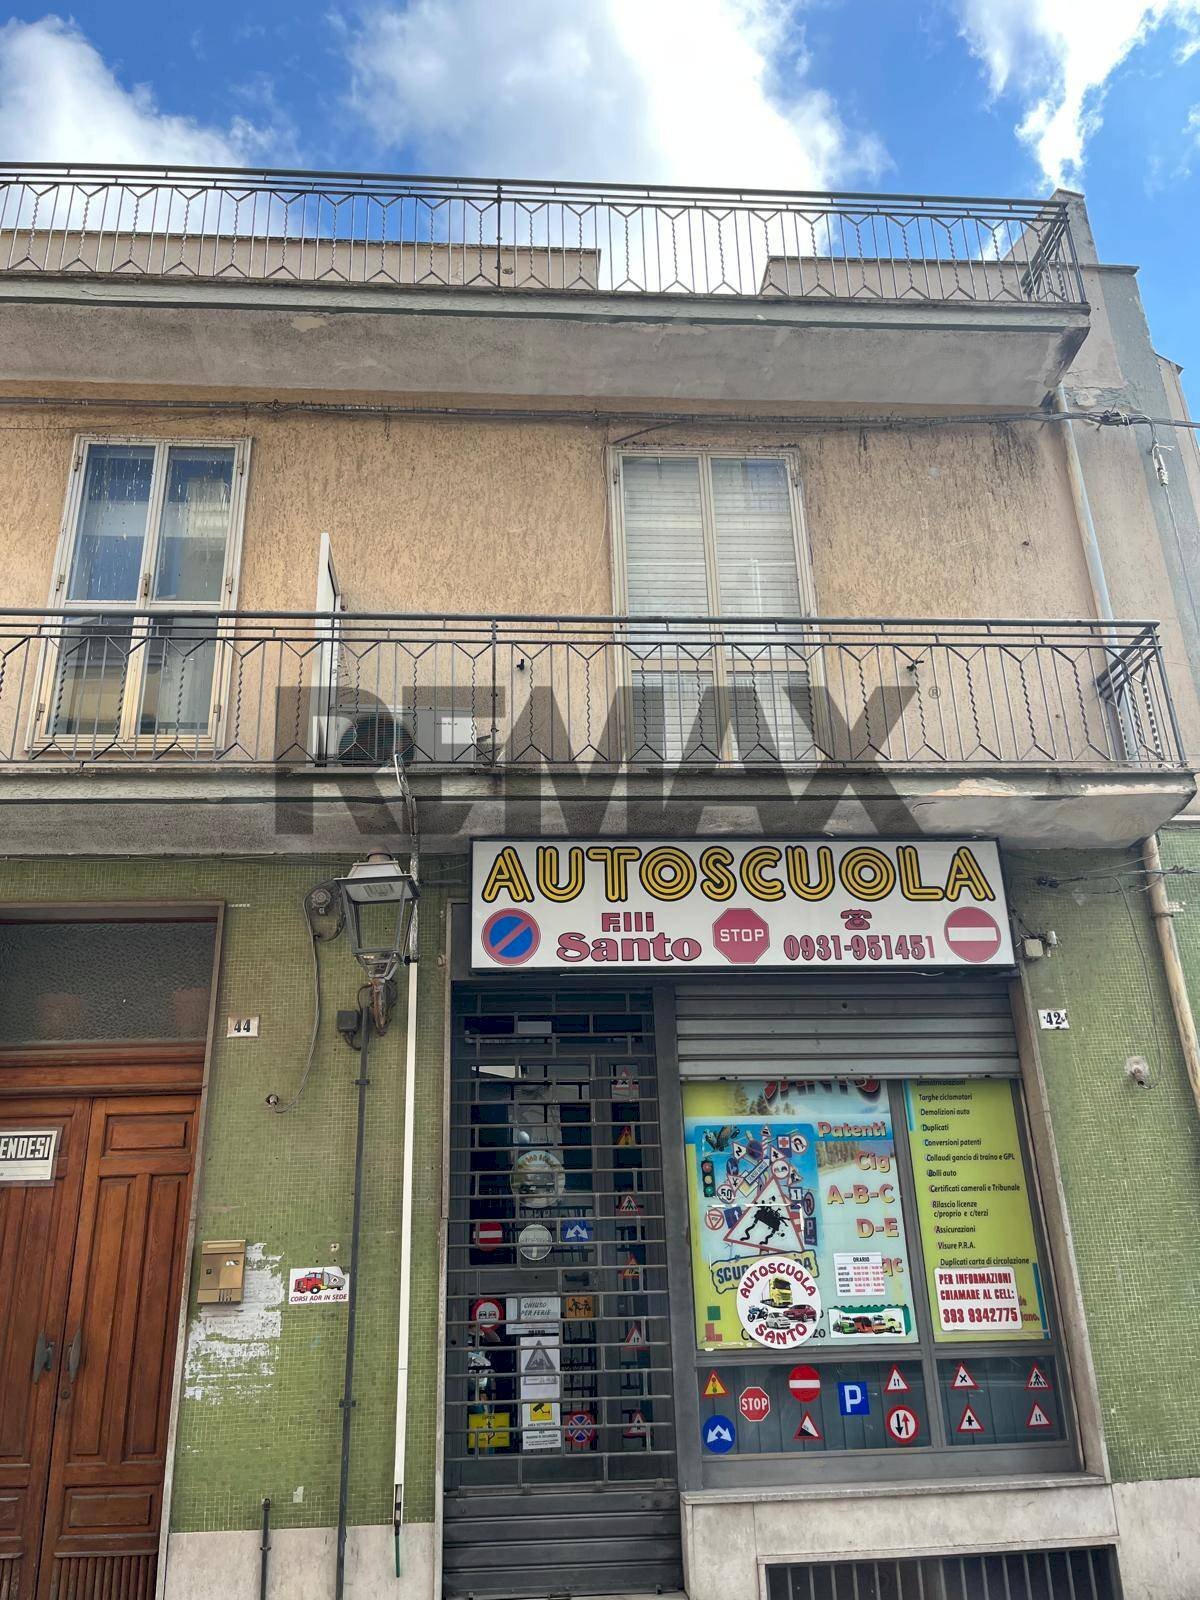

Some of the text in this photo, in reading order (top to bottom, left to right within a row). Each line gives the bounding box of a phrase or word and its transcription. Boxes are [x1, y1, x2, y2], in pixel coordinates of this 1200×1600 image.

[481, 845, 996, 903] AUTOSCUOLA
[719, 928, 765, 943] STOP
[556, 932, 702, 962] Santo
[783, 934, 936, 961] 0931-951451
[234, 1018, 251, 1033] 44
[919, 1093, 973, 1102] Targhe ciclomotori
[920, 1108, 956, 1116] Demolizioni
[817, 1120, 888, 1138] Patenti
[922, 1123, 949, 1133] Duplicati
[0, 1136, 50, 1159] ENDESI
[924, 1138, 982, 1147] Conversioni patenti
[926, 1153, 951, 1161] Collaudi
[951, 1154, 972, 1163] gancio
[972, 1153, 979, 1161] di
[979, 1153, 998, 1161] traino
[927, 1169, 942, 1177] Bolli
[827, 1183, 896, 1205] A-B-C
[930, 1184, 959, 1193] Certificati
[960, 1184, 987, 1192] camerali
[992, 1184, 1021, 1192] Tribunale
[932, 1200, 977, 1208] Rilascio licenze
[933, 1209, 962, 1219] c/proprio
[969, 1209, 989, 1217] c/terzi
[857, 1217, 899, 1238] D-E
[935, 1225, 976, 1233] Assicurazioni
[937, 1241, 976, 1250] Visure P.R.A.
[940, 1257, 1030, 1267] Duplicati carta di circolazione
[739, 1262, 817, 1299] AUTOSCUOLA
[938, 1272, 1012, 1285] PER INFORMAZIONI
[332, 1293, 348, 1301] SEDE
[940, 1288, 1015, 1301] CHIAMARE AL CELL:
[755, 1323, 808, 1345] SANTO
[741, 1397, 768, 1410] STOP
[843, 1384, 862, 1413] P
